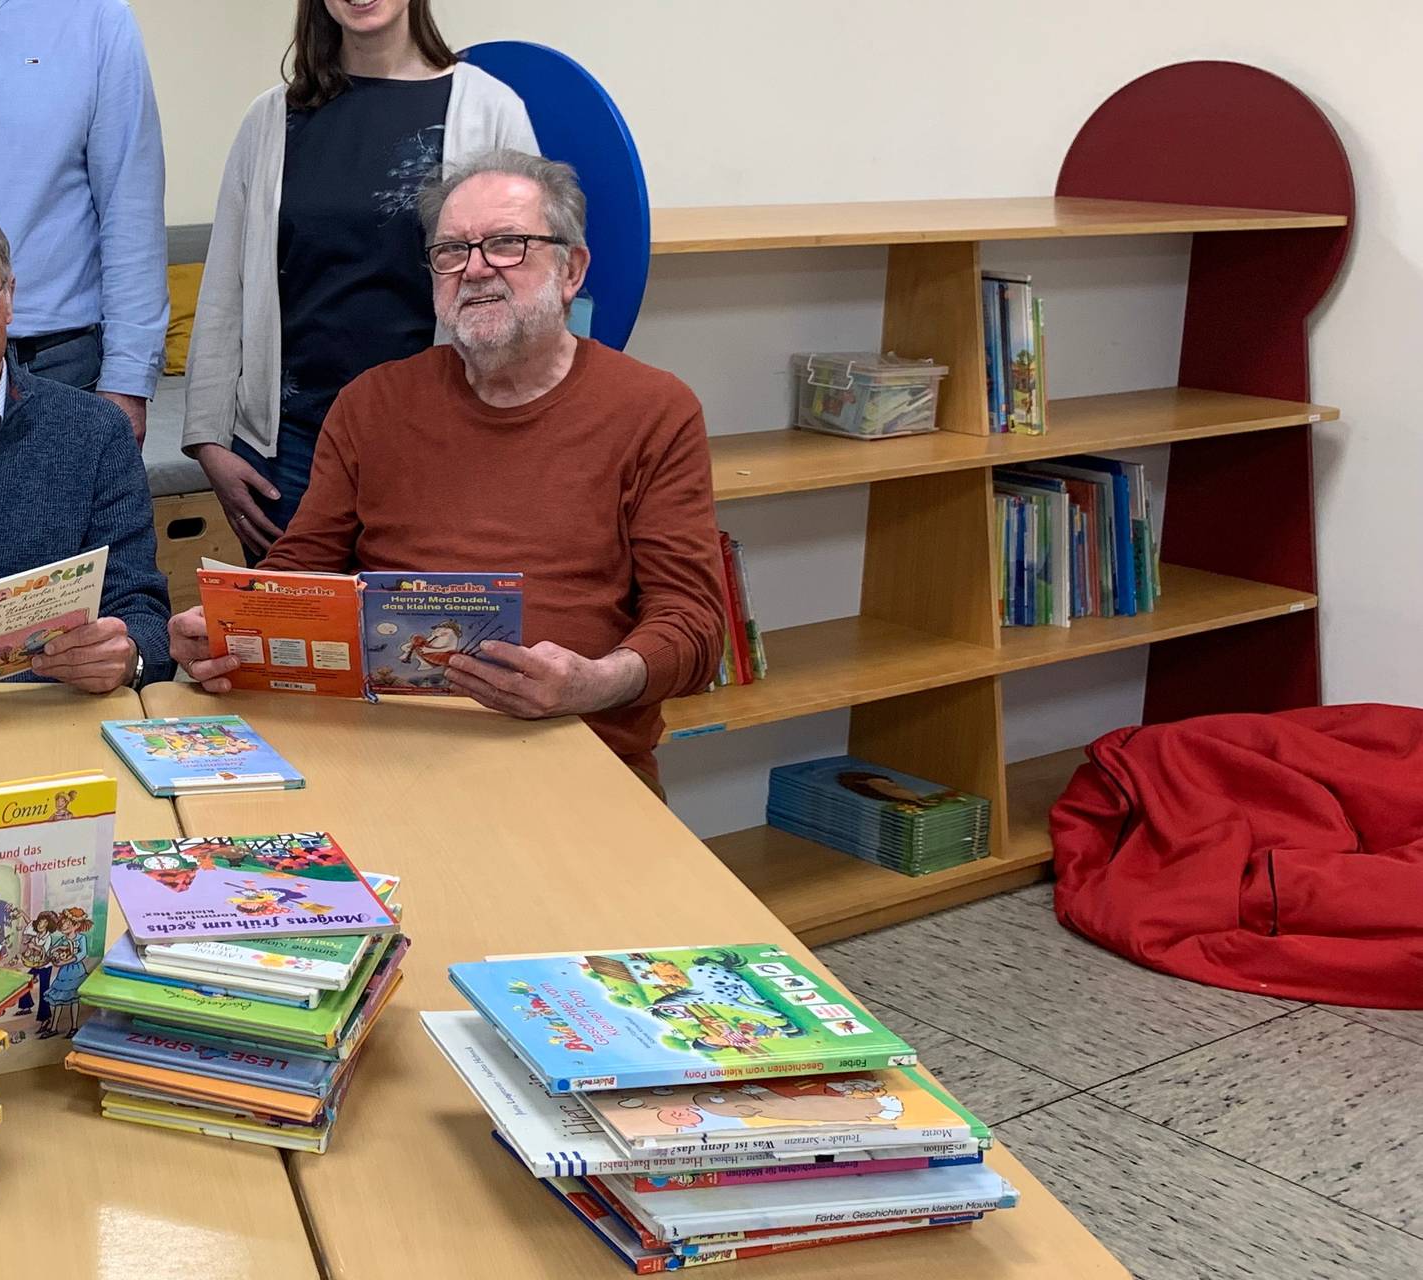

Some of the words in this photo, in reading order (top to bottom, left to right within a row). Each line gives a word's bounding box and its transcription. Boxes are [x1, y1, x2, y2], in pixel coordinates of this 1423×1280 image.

[265, 581, 336, 597] Leserabe
[413, 580, 486, 594] Leserabe
[391, 596, 425, 605] Henry
[428, 596, 491, 605] MacDudel,
[444, 604, 501, 612] Gespenst
[1, 799, 50, 824] Conni
[0, 846, 20, 860] und
[23, 845, 42, 857] das
[13, 855, 87, 875] Hochzeitsfest
[197, 912, 238, 920] kommt
[241, 914, 283, 930] früh
[286, 912, 365, 925] Morgens
[146, 920, 197, 933] sechs
[202, 920, 231, 932] um
[302, 944, 340, 957] Simone
[557, 1000, 610, 1046] Geschichten
[126, 1032, 201, 1052] SPATZ
[709, 1066, 744, 1078] kleinen
[745, 1066, 769, 1075] vom
[770, 1061, 824, 1073] Geschichten
[683, 1068, 708, 1081] Pony
[828, 1133, 862, 1145] Teulade
[921, 1129, 953, 1138] Moritz
[734, 1140, 750, 1150] ist
[753, 1139, 776, 1150] Was
[784, 1135, 820, 1146] Sarrazin
[670, 1143, 694, 1155] das?
[695, 1142, 731, 1153] denn
[652, 1158, 677, 1168] mein
[679, 1156, 704, 1168] Hier,
[852, 1207, 908, 1220] Geschichten
[910, 1206, 930, 1215] vom
[931, 1202, 963, 1212] kleinen
